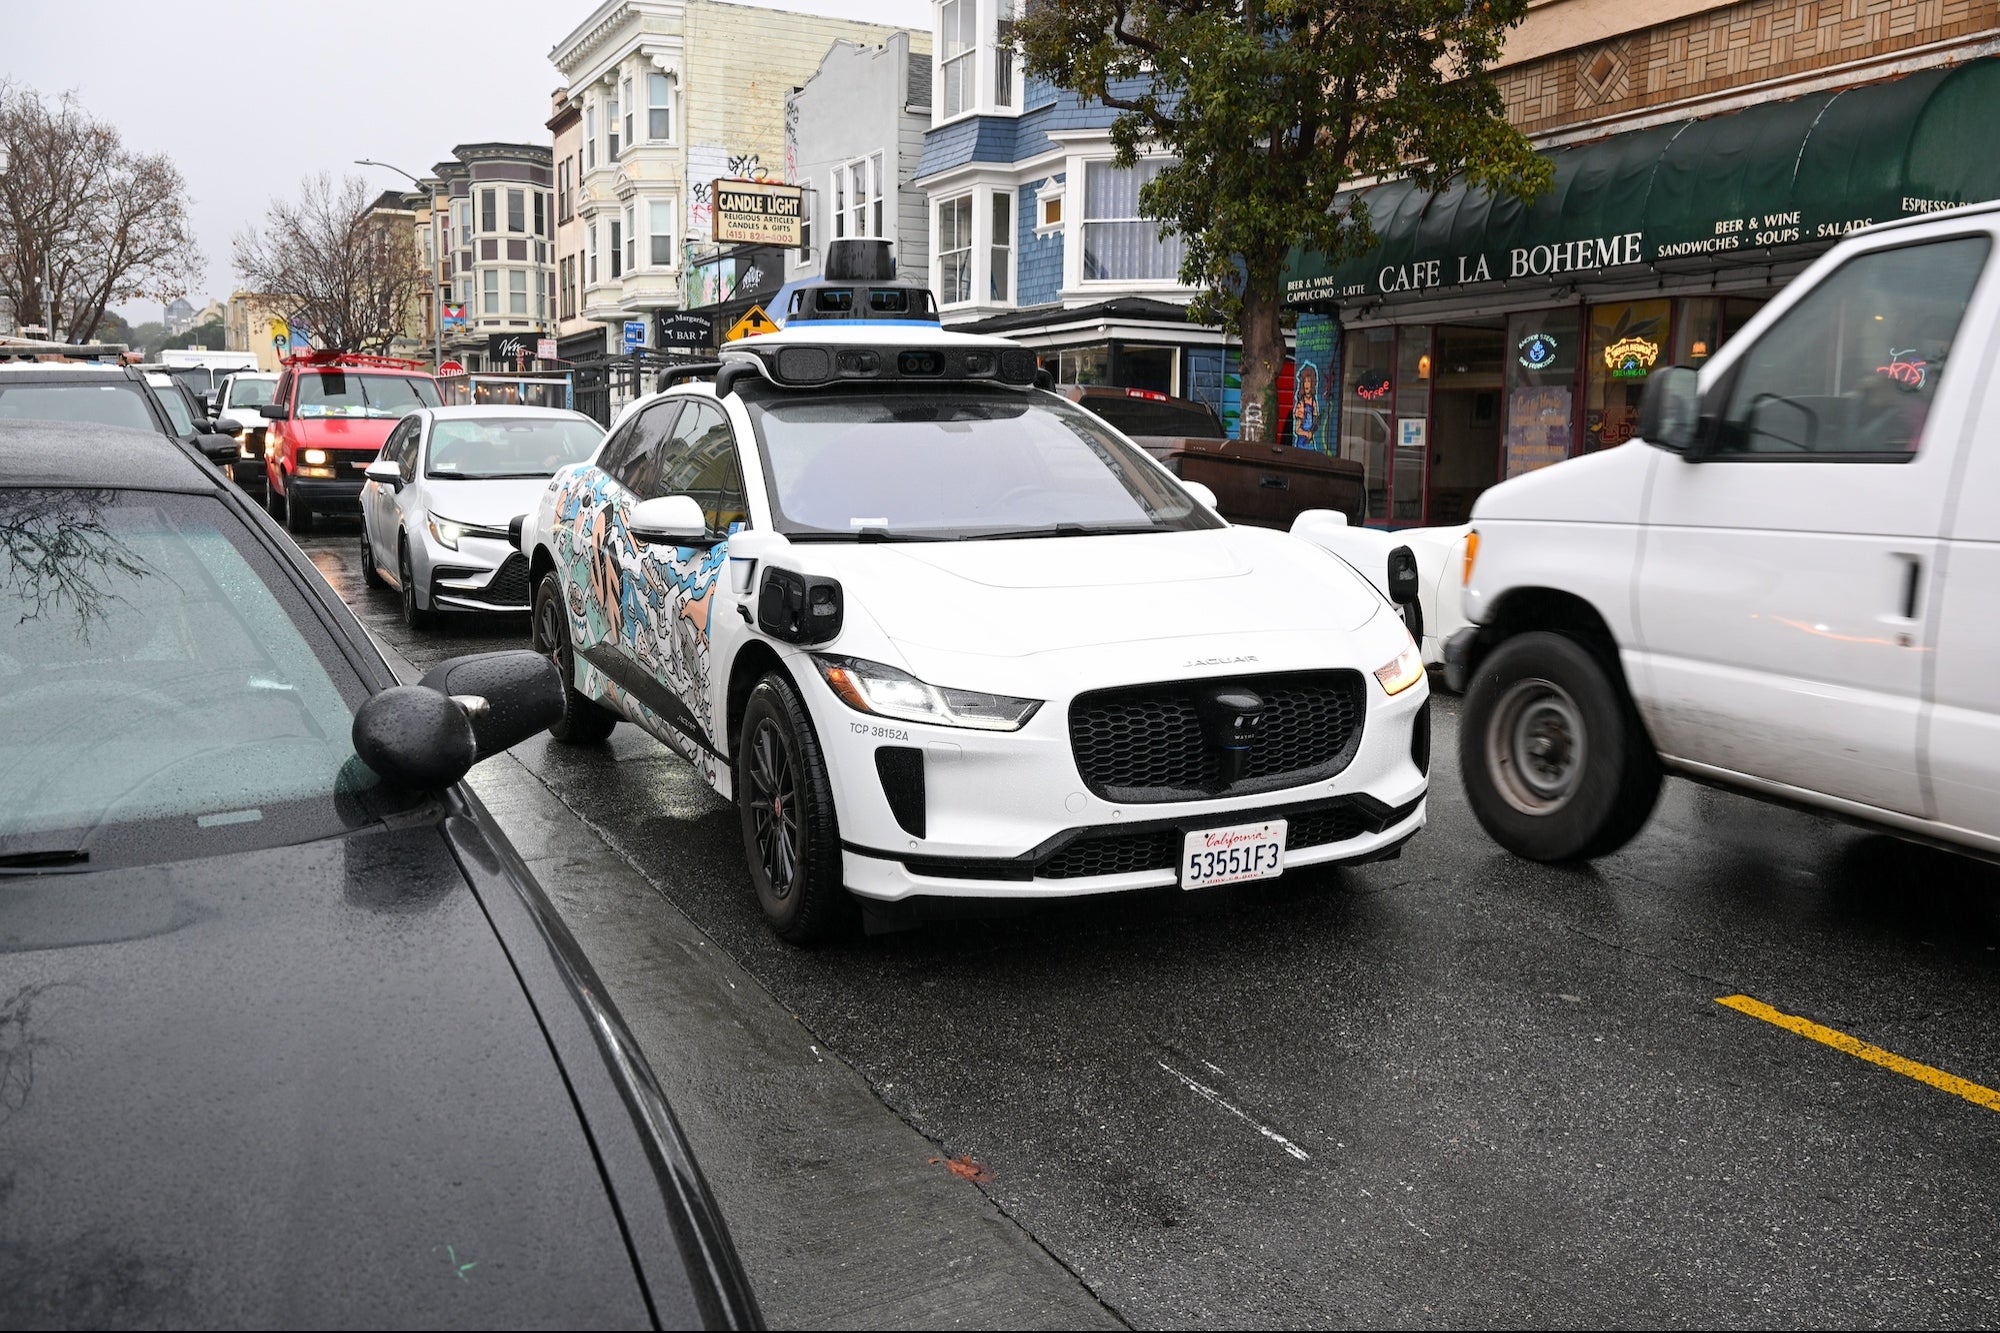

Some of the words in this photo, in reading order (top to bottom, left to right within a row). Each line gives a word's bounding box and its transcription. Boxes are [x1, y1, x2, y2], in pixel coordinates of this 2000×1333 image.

[719, 193, 763, 213] CANDLE
[767, 194, 799, 216] LIGHT
[1901, 196, 1956, 213] ESPRESSO
[724, 213, 761, 222] RELIGIOUS
[763, 216, 794, 225] ARTICLES
[728, 222, 760, 230] CANDLES
[771, 225, 791, 233] GIFTS
[1714, 218, 1744, 236] BEER
[1748, 217, 1759, 230] &
[1763, 210, 1801, 228] WINE
[727, 230, 746, 239] (415)
[1657, 236, 1739, 258] SANDWICHES
[1755, 227, 1800, 246] SOUPS
[1816, 217, 1874, 238] SALADS
[1378, 259, 1441, 294] CAFE
[1457, 253, 1492, 285] LA
[1510, 232, 1643, 278] BOHEME
[1287, 279, 1304, 291] BEER
[1305, 278, 1312, 289] &
[1313, 275, 1335, 287] WINE
[1286, 287, 1335, 303] CAPPUCCINO
[1342, 284, 1366, 297] LATTE
[661, 316, 674, 326] Las
[674, 314, 711, 328] Margaritas
[676, 331, 696, 340] BAR
[440, 368, 464, 377] STOP
[1357, 380, 1390, 400] Coffee
[849, 722, 869, 734] TCP
[871, 726, 909, 742] 38152A
[1206, 831, 1267, 848] California
[1190, 843, 1279, 881] 53551F3
